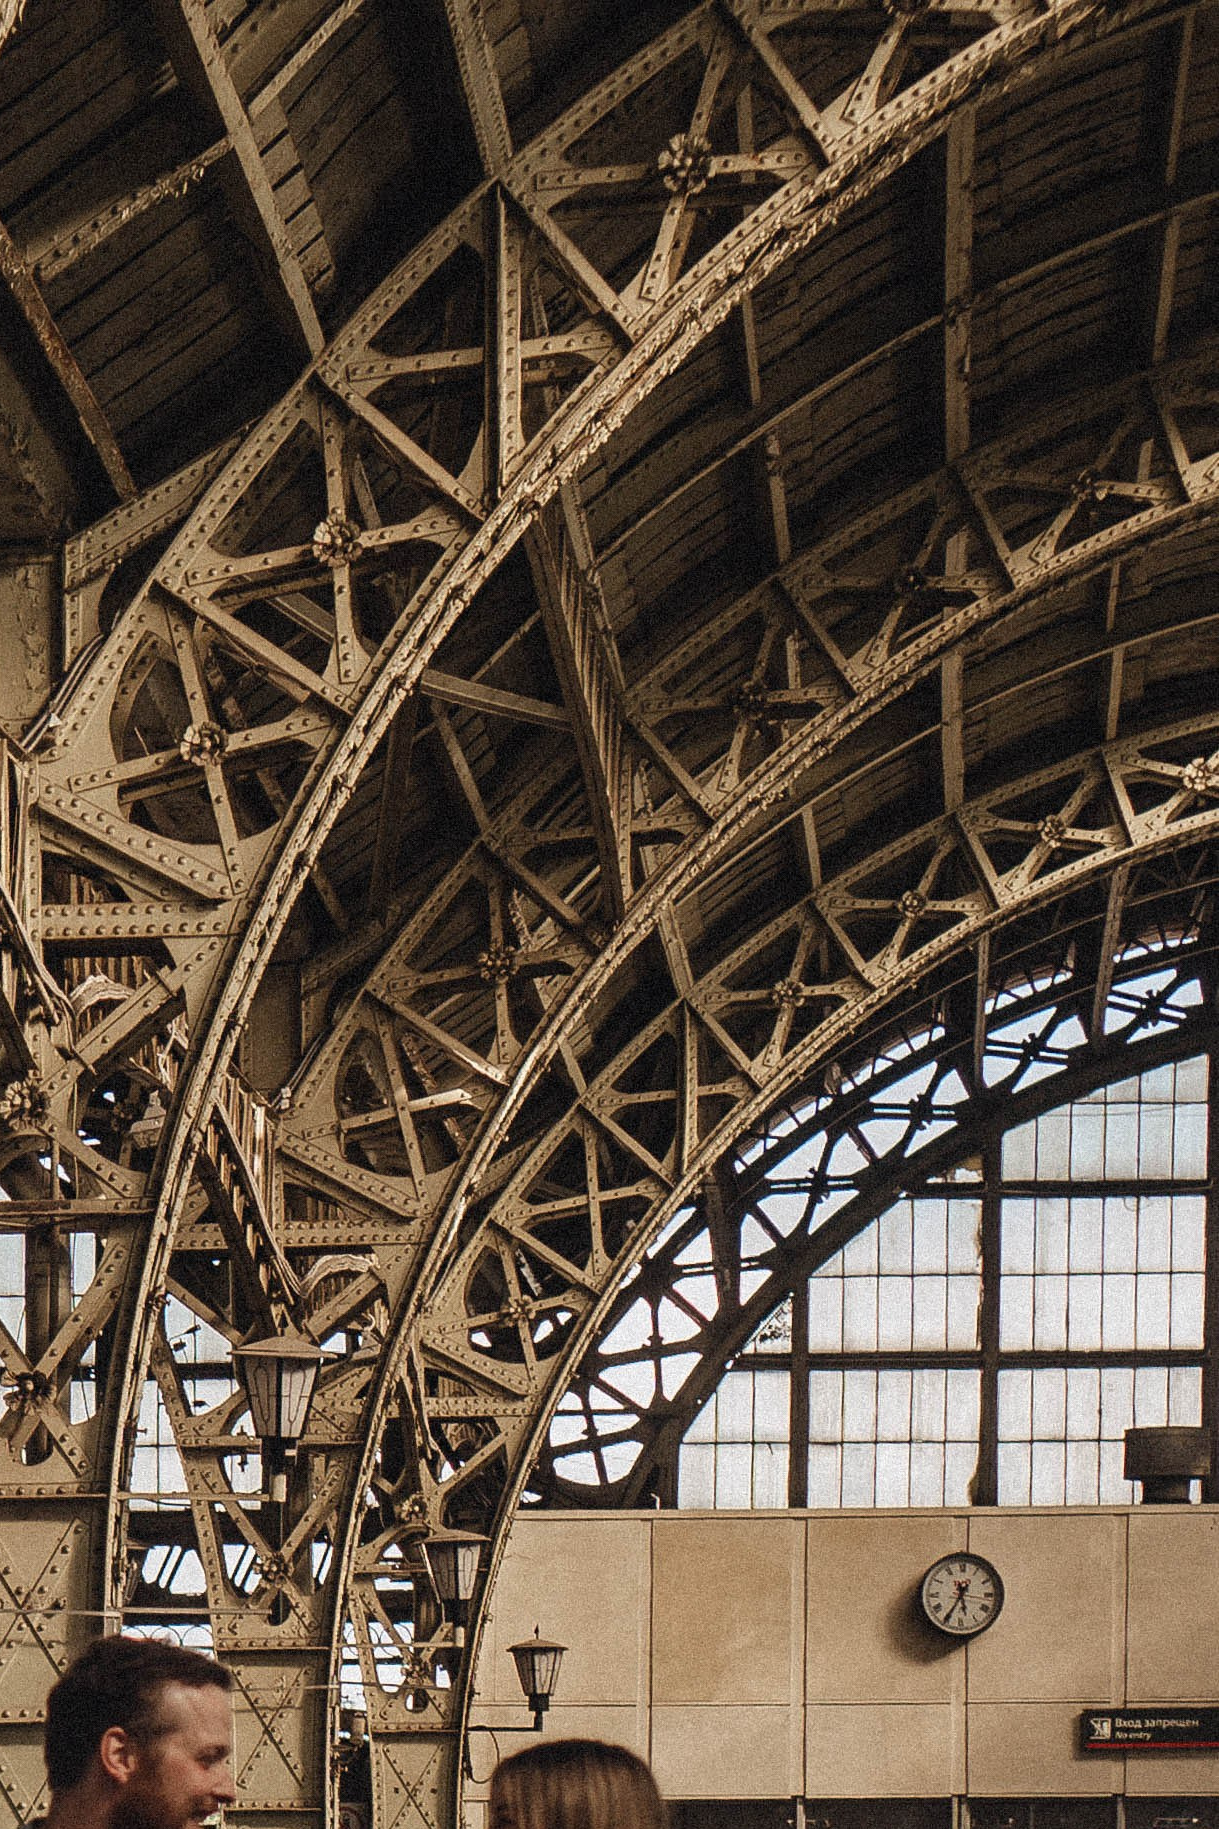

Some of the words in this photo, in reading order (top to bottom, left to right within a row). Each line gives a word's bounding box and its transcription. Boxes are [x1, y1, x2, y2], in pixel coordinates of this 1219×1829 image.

[1115, 1718, 1142, 1728] Вход
[1144, 1718, 1200, 1729] запрещен
[1115, 1731, 1128, 1739] No
